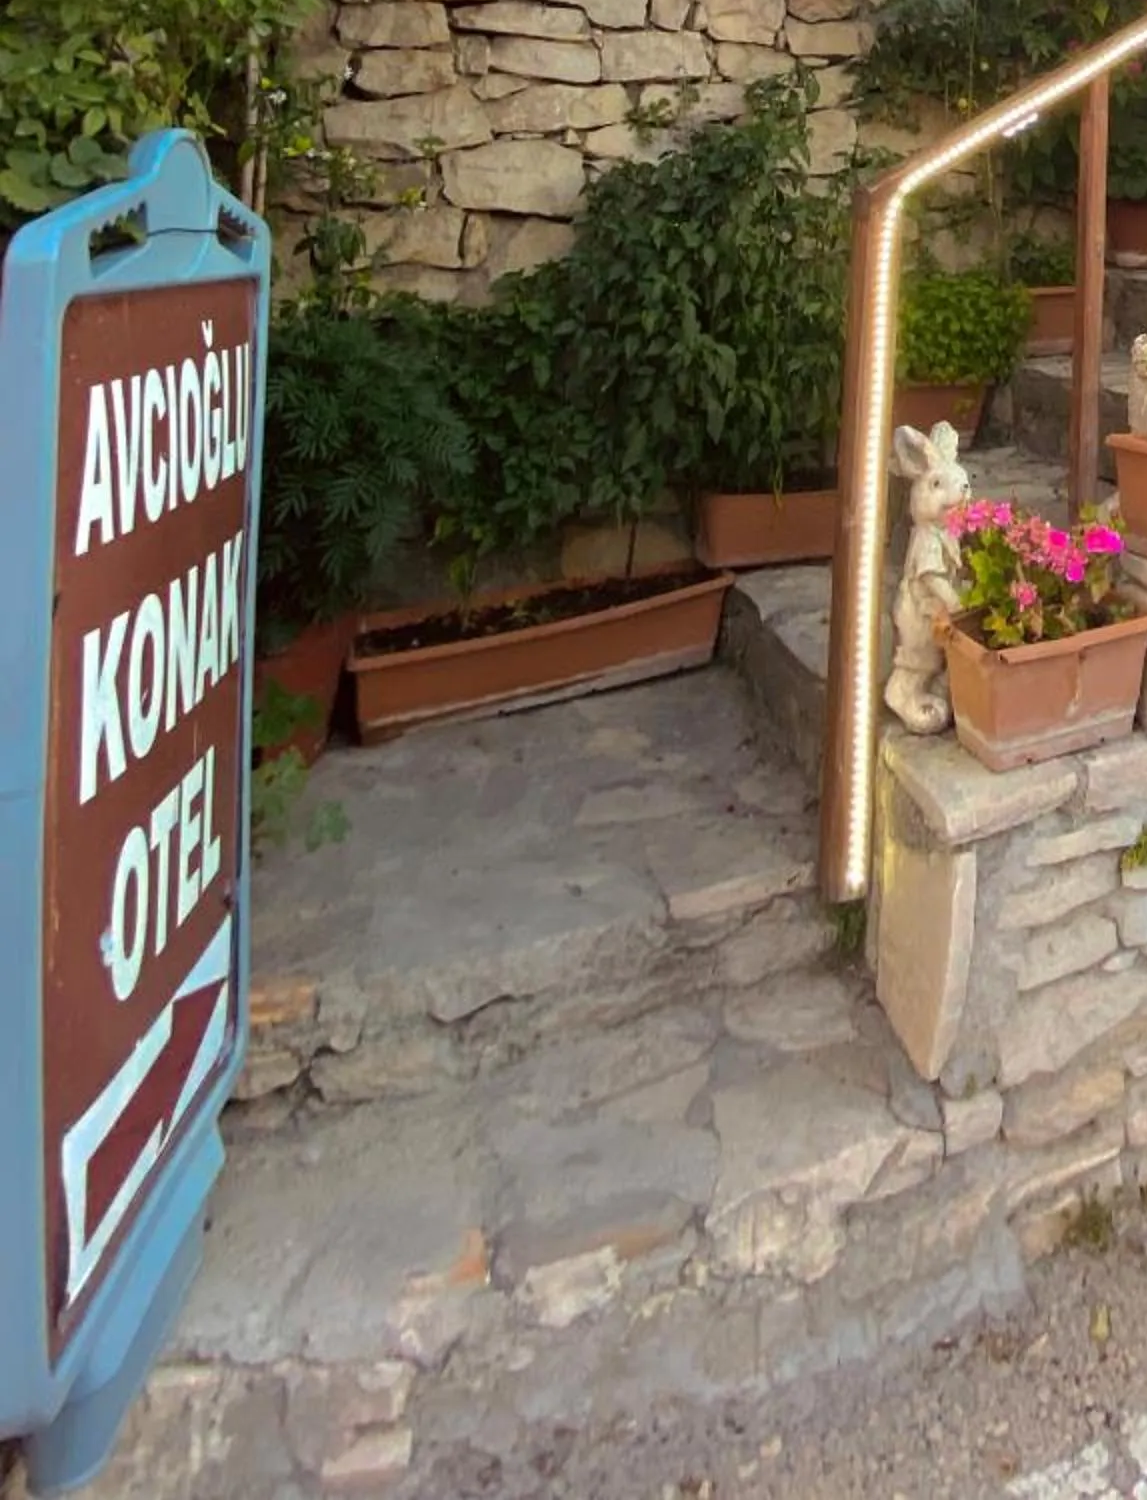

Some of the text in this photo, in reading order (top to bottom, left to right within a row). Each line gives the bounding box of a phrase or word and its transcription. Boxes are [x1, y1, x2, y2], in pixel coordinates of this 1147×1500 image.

[75, 320, 249, 556] AVCIOĞLU
[80, 530, 245, 805] KONAK
[110, 746, 223, 1002] OTEL
